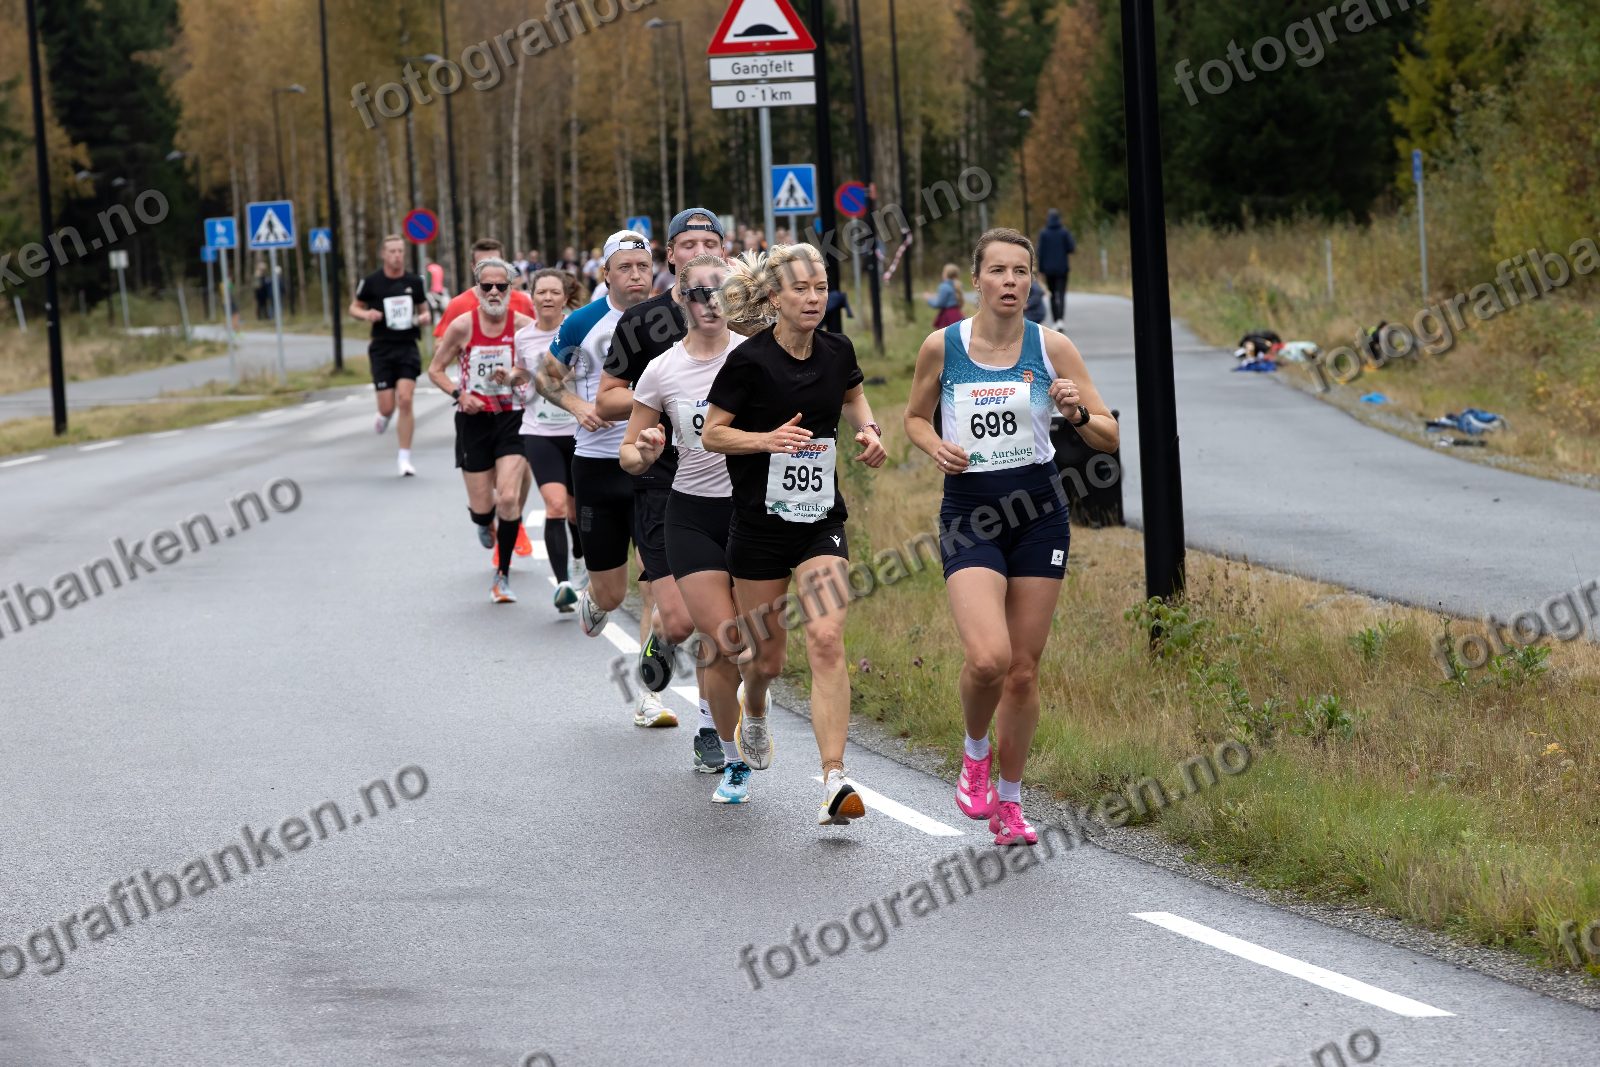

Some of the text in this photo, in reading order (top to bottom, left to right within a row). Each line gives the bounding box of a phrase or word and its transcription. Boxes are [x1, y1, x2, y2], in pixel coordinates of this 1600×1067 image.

[731, 60, 794, 76] Gangfelt
[736, 90, 745, 102] 0
[761, 89, 766, 101] 1
[771, 89, 792, 101] km
[970, 387, 1016, 397] NORGES
[974, 396, 1009, 406] LØPET
[970, 410, 1018, 439] 698
[990, 446, 1033, 460] Aurskog
[781, 465, 823, 492] 595
